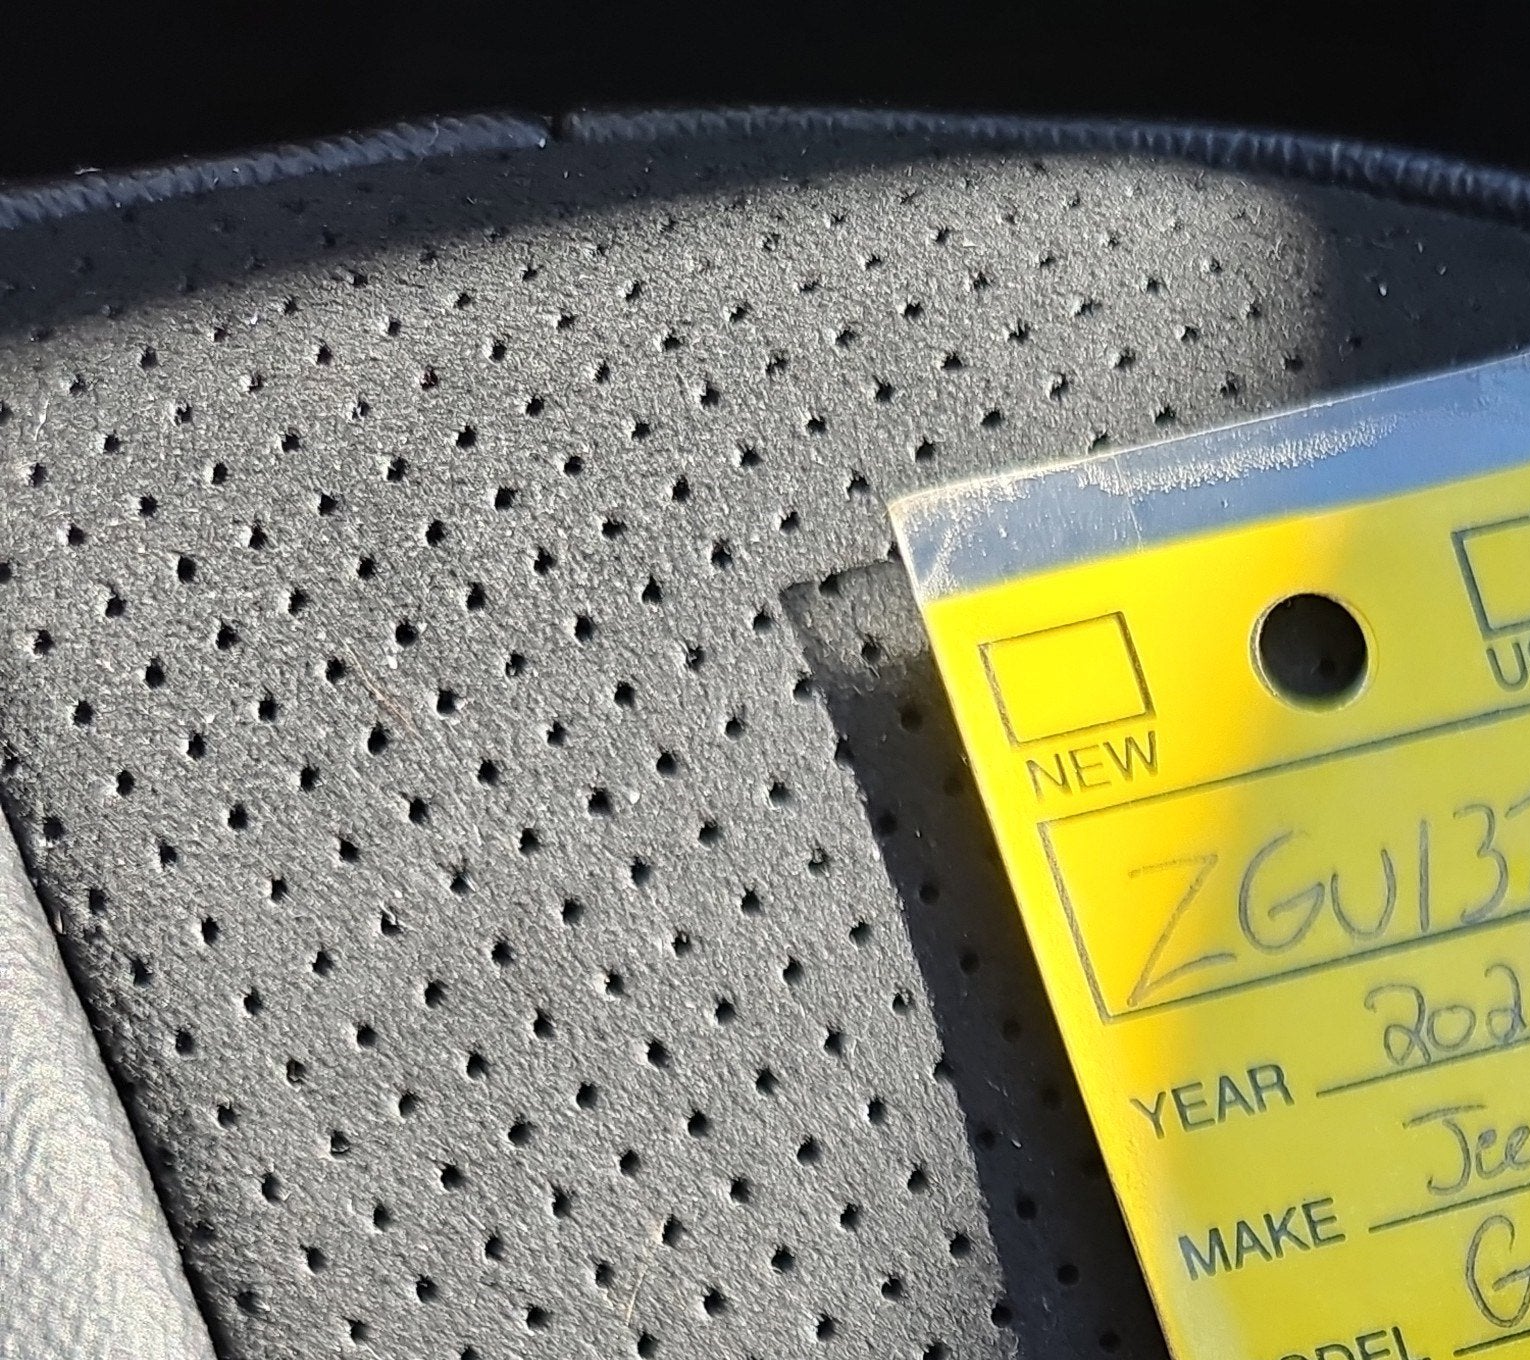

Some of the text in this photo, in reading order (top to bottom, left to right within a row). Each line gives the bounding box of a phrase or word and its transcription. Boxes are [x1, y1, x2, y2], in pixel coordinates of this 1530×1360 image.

[1029, 731, 1160, 798] NEW
[1131, 1062, 1293, 1141] YEAR
[1177, 1198, 1346, 1282] MAKE
